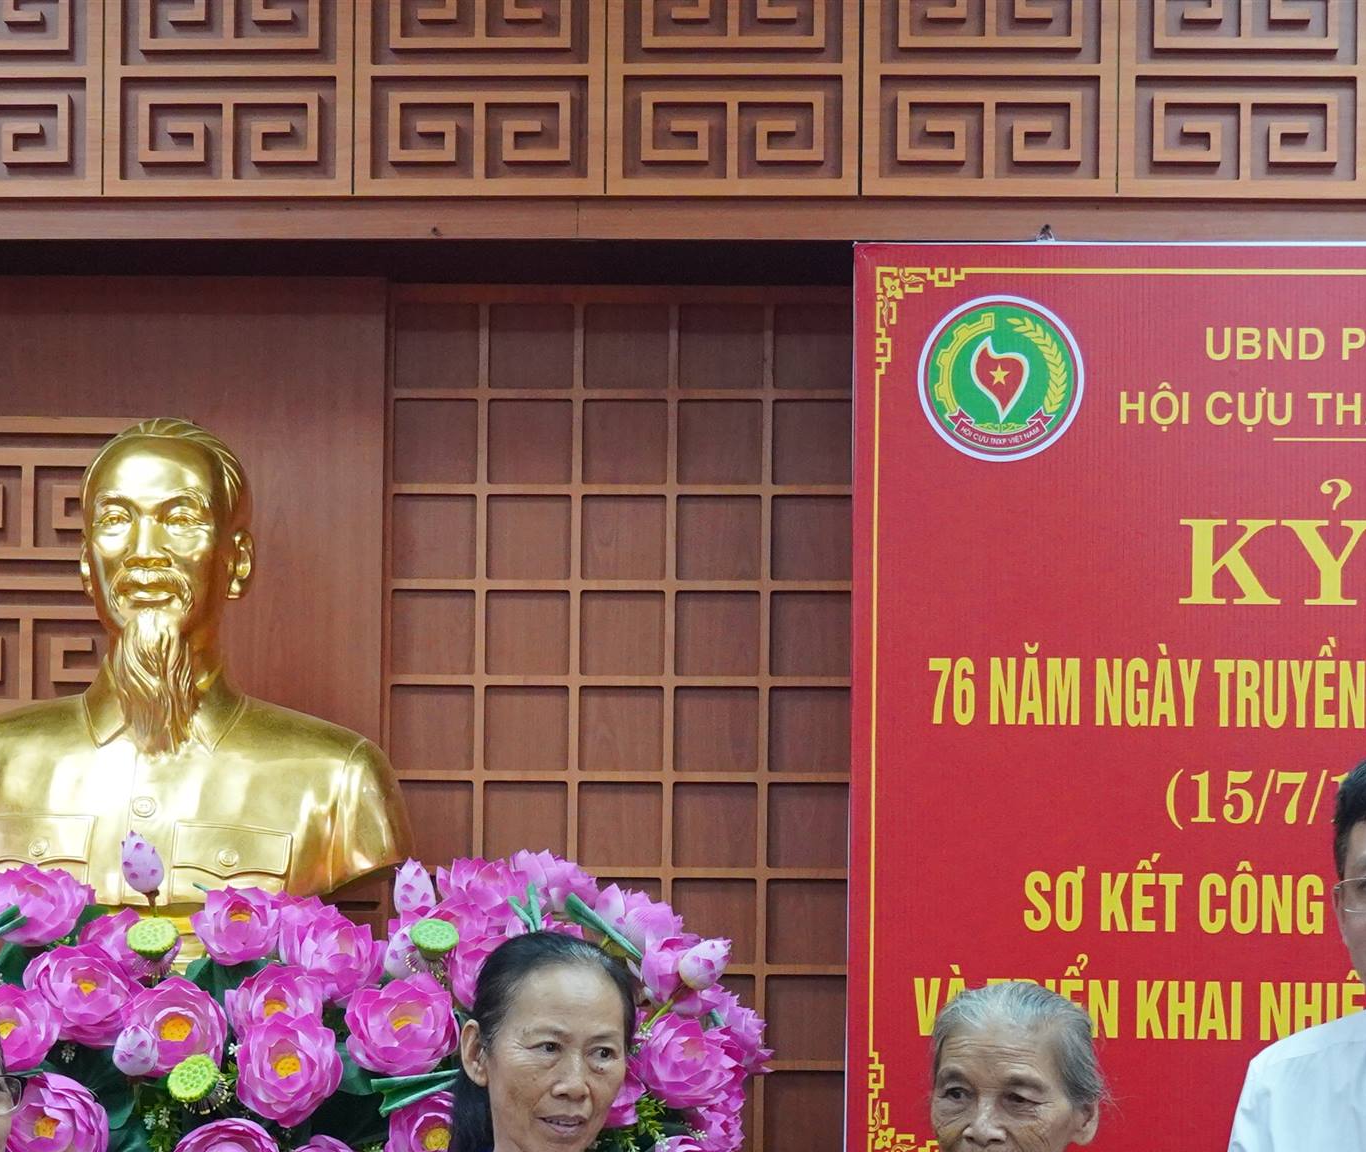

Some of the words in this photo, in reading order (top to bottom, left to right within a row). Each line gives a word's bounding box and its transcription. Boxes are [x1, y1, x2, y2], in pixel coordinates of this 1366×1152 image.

[1207, 327, 1324, 360] UBND
[1120, 384, 1189, 432] HỘI
[1205, 391, 1293, 432] CỰU
[929, 657, 975, 725] 76
[990, 643, 1080, 725] NĂM
[1096, 643, 1201, 727] NGÀY
[1214, 637, 1366, 729] TRUYỀN
[1024, 866, 1085, 931] SƠ
[1101, 853, 1183, 932] KẾT
[1199, 861, 1324, 934] CÔNG
[1137, 980, 1242, 1040] KHAI
